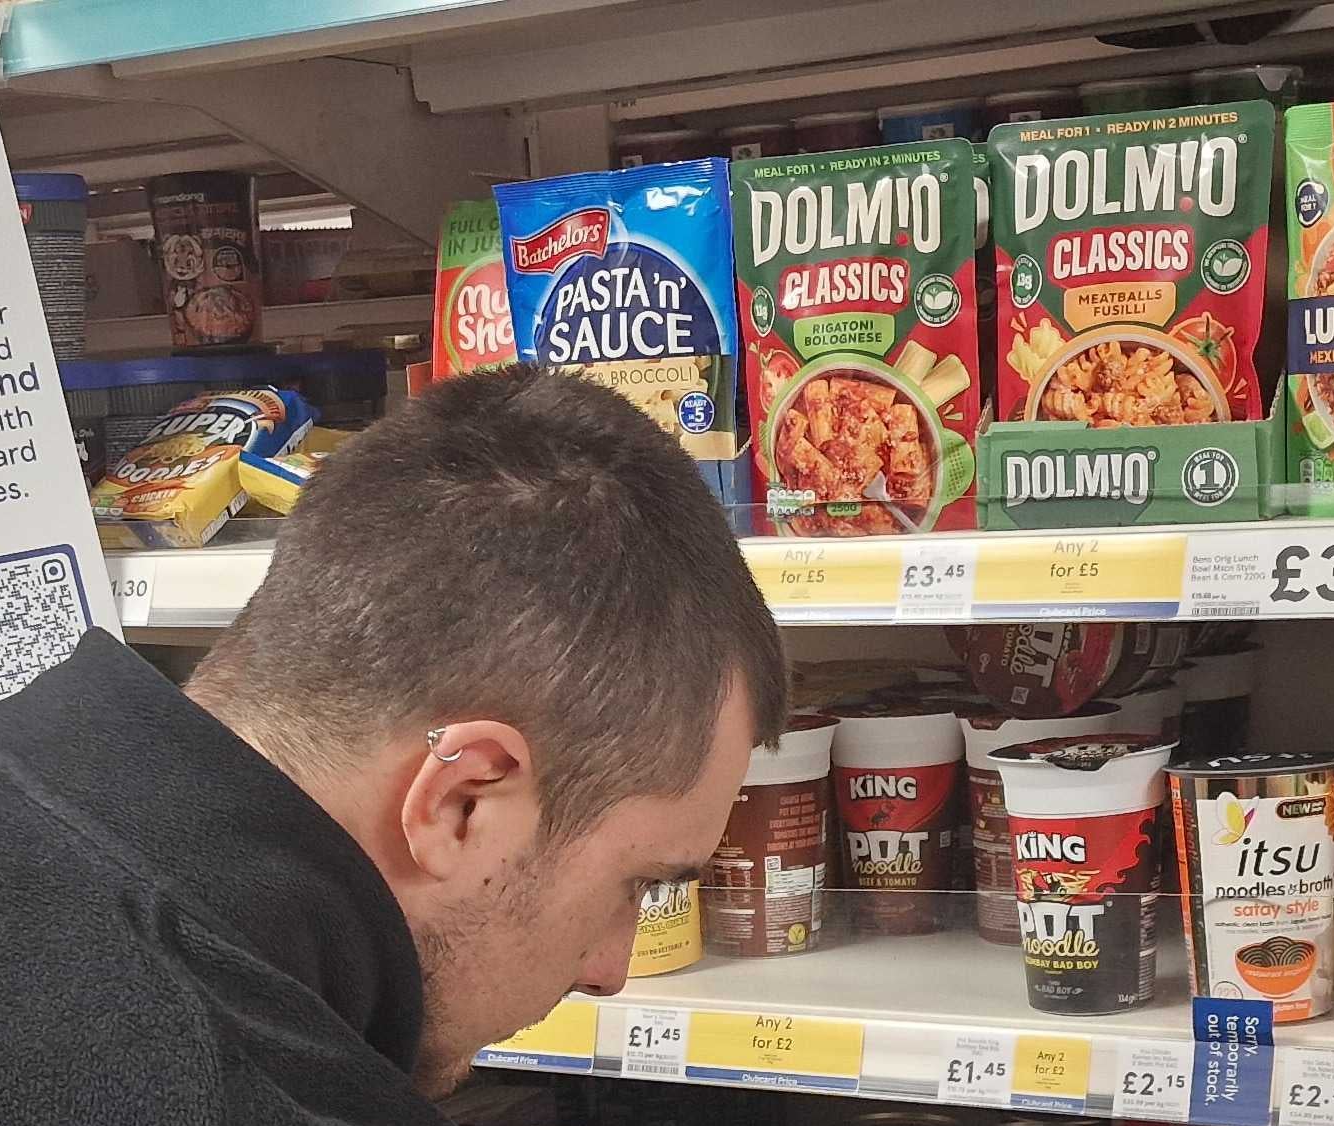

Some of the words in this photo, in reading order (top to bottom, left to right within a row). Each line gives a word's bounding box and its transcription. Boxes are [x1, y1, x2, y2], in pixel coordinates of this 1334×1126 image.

[515, 218, 603, 268] Batchelors
[1053, 232, 1189, 281] CLASSICS
[557, 268, 647, 317] PASTA
[1078, 289, 1163, 306] MEATBALLS
[1093, 302, 1147, 317] FUSILLI
[549, 315, 695, 362] SAUCE
[803, 330, 883, 346] BOLOGNESE
[811, 320, 875, 334] RIGATONI
[611, 366, 693, 387] BROCCOLI
[1050, 563, 1075, 578] for
[1079, 562, 1099, 578] £5
[850, 774, 917, 799] KING
[848, 831, 928, 861] POT
[1016, 831, 1085, 861] KING
[1237, 837, 1320, 876] itsu
[1216, 882, 1285, 899] noodles
[1300, 876, 1332, 894] broth
[1234, 903, 1281, 918] satay
[1286, 899, 1319, 915] style
[1208, 1014, 1219, 1034] out
[628, 1026, 681, 1049] £1.45
[1208, 1039, 1219, 1055] of
[1245, 1017, 1260, 1056] Sorry,
[1225, 1015, 1239, 1101] temporarily
[947, 1060, 1006, 1083] £1.45
[1122, 1071, 1185, 1096] £2.15
[1205, 1060, 1219, 1106] stock.
